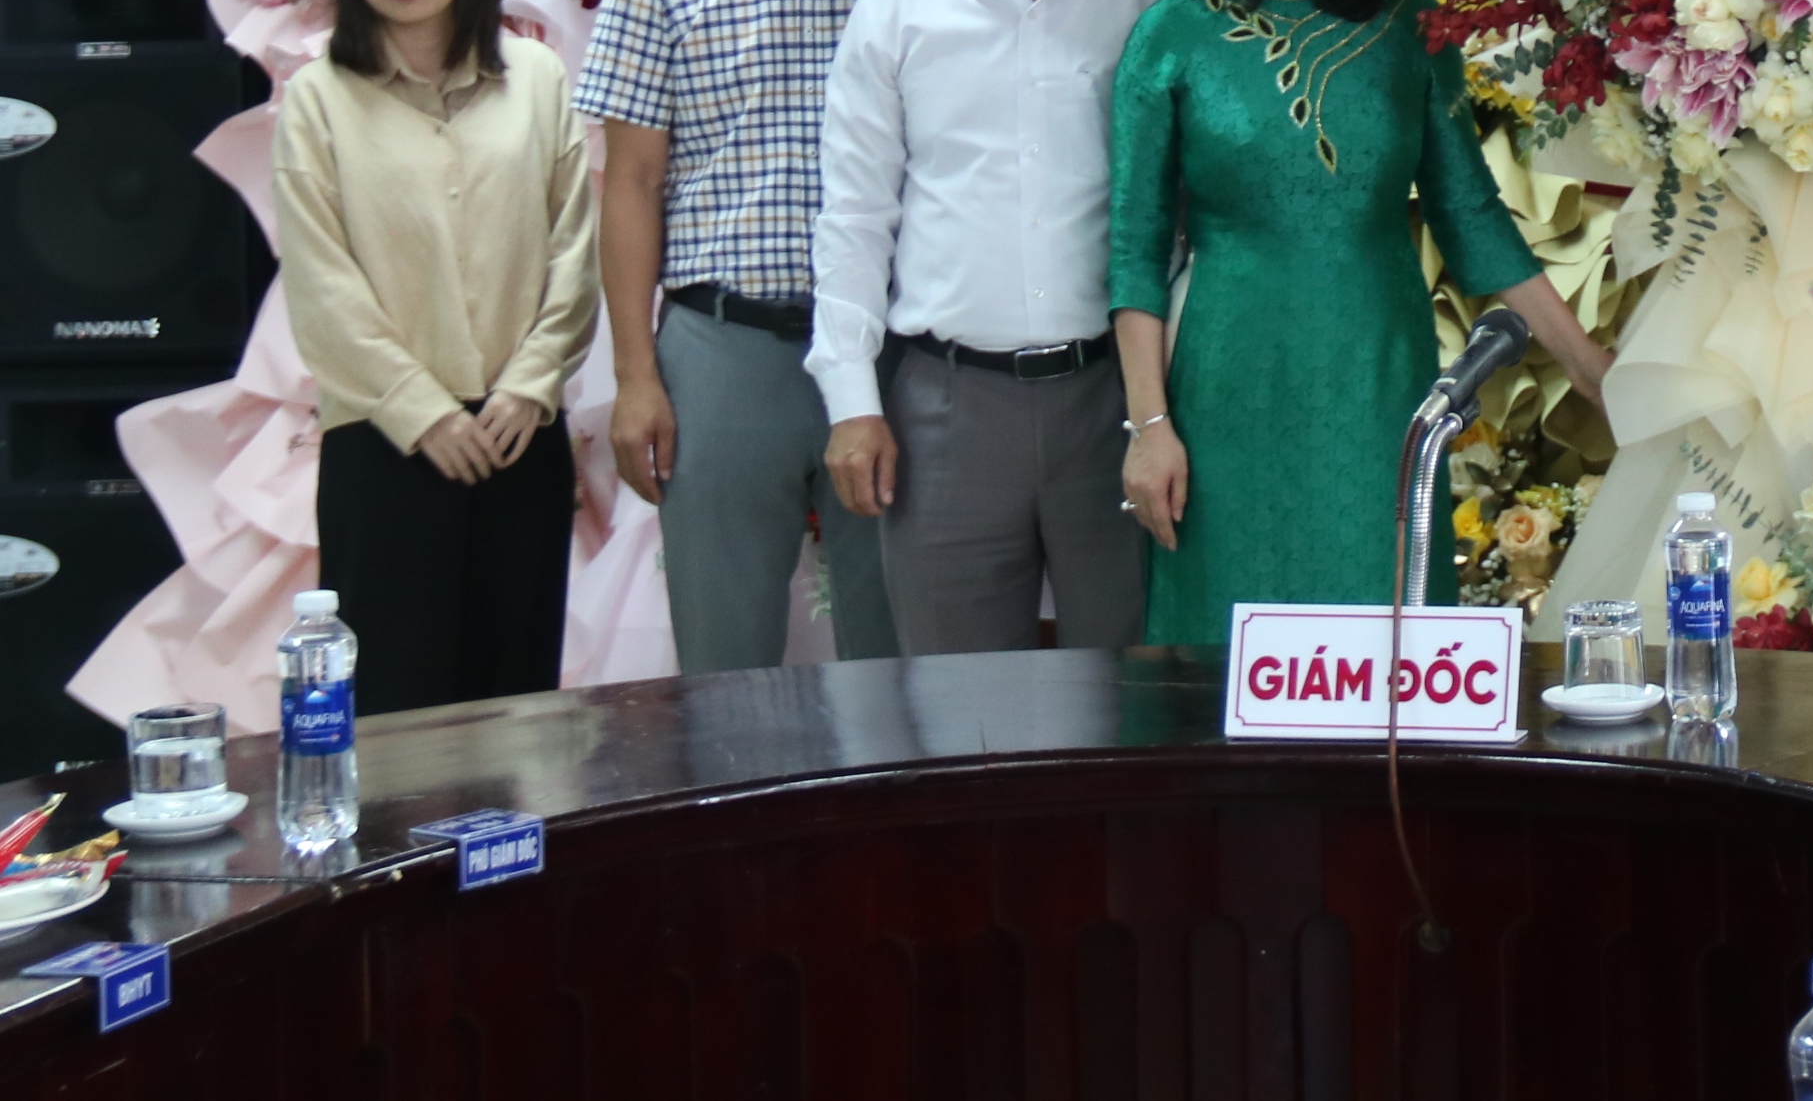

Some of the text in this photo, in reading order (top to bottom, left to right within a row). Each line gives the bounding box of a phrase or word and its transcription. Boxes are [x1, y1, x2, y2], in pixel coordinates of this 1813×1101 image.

[1680, 598, 1725, 614] AQUAFINA
[1248, 642, 1499, 705] GIÁM ĐỐC
